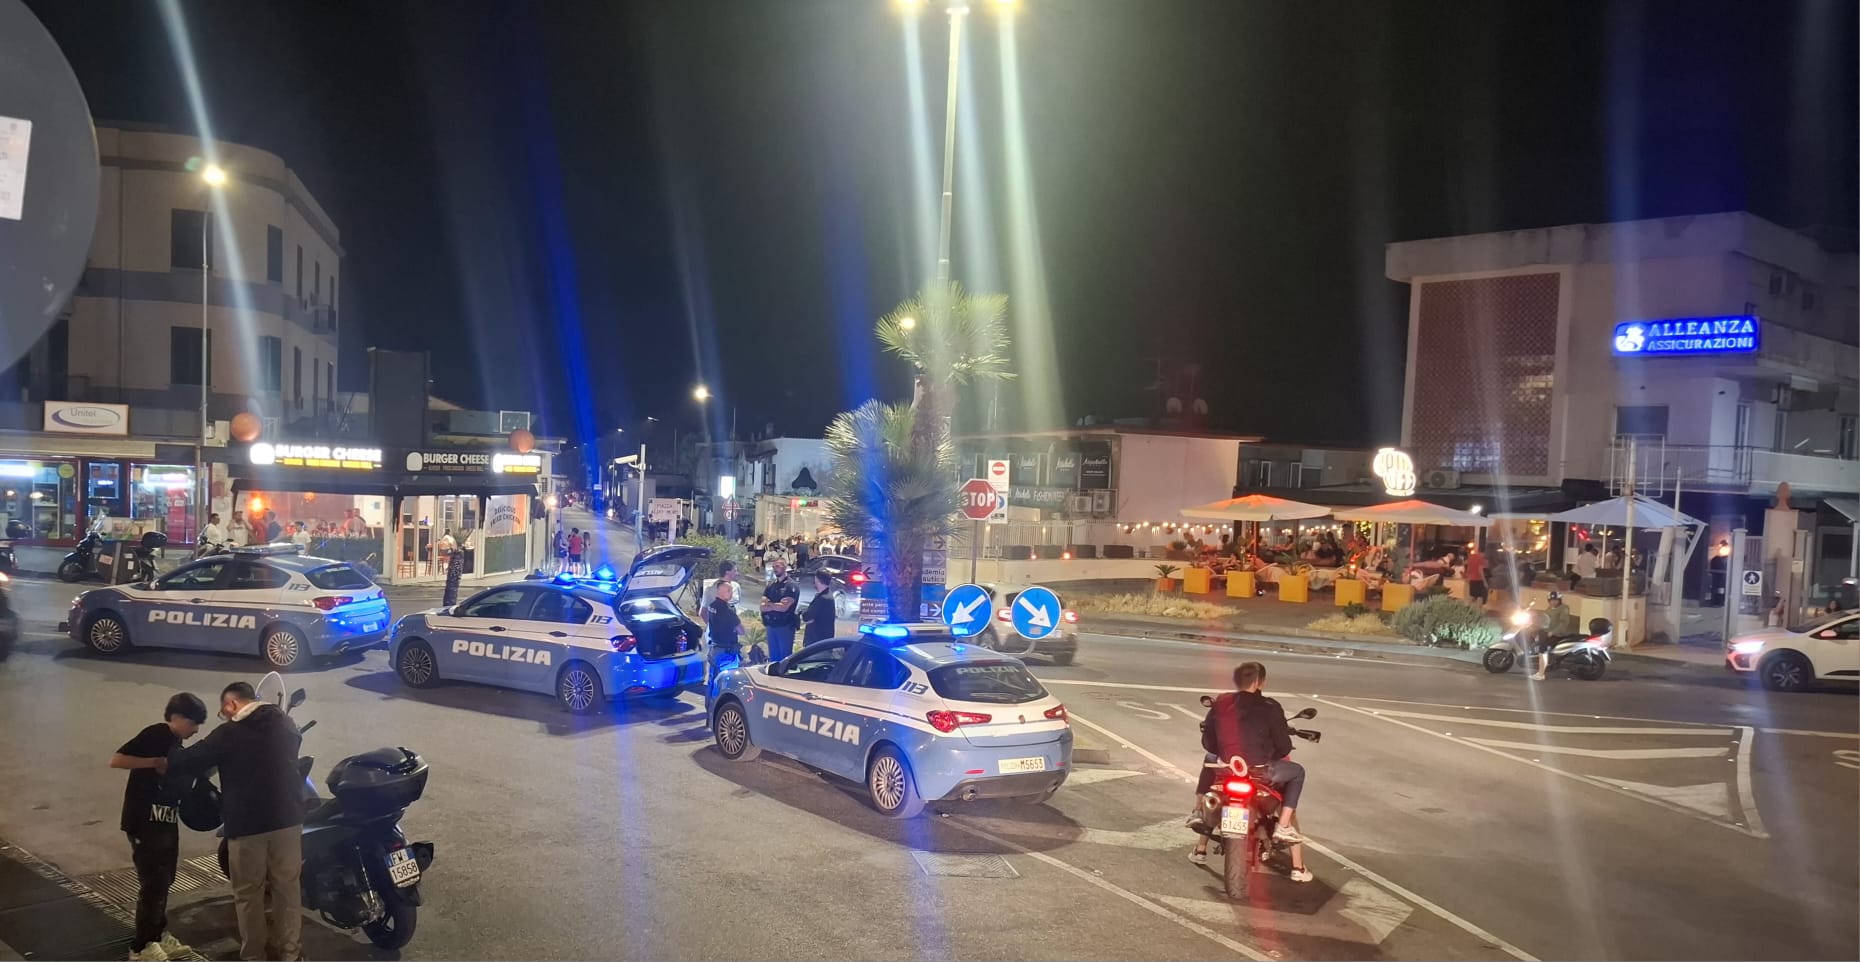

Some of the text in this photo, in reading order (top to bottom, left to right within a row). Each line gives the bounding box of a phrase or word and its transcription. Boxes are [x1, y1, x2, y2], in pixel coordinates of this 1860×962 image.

[1649, 320, 1754, 337] ALLEANZA
[1647, 337, 1753, 351] ASSICURAZIONI
[423, 453, 489, 465] BURGER CHEESE
[961, 491, 996, 508] STOP
[288, 583, 310, 592] 113
[148, 610, 256, 629] POLIZIA
[589, 614, 613, 625] 113
[452, 639, 551, 666] POLIZIA
[955, 665, 1019, 675] POLIZIA
[902, 680, 929, 695] 113
[762, 701, 860, 746] POLIZIA
[391, 861, 418, 881] 15858
